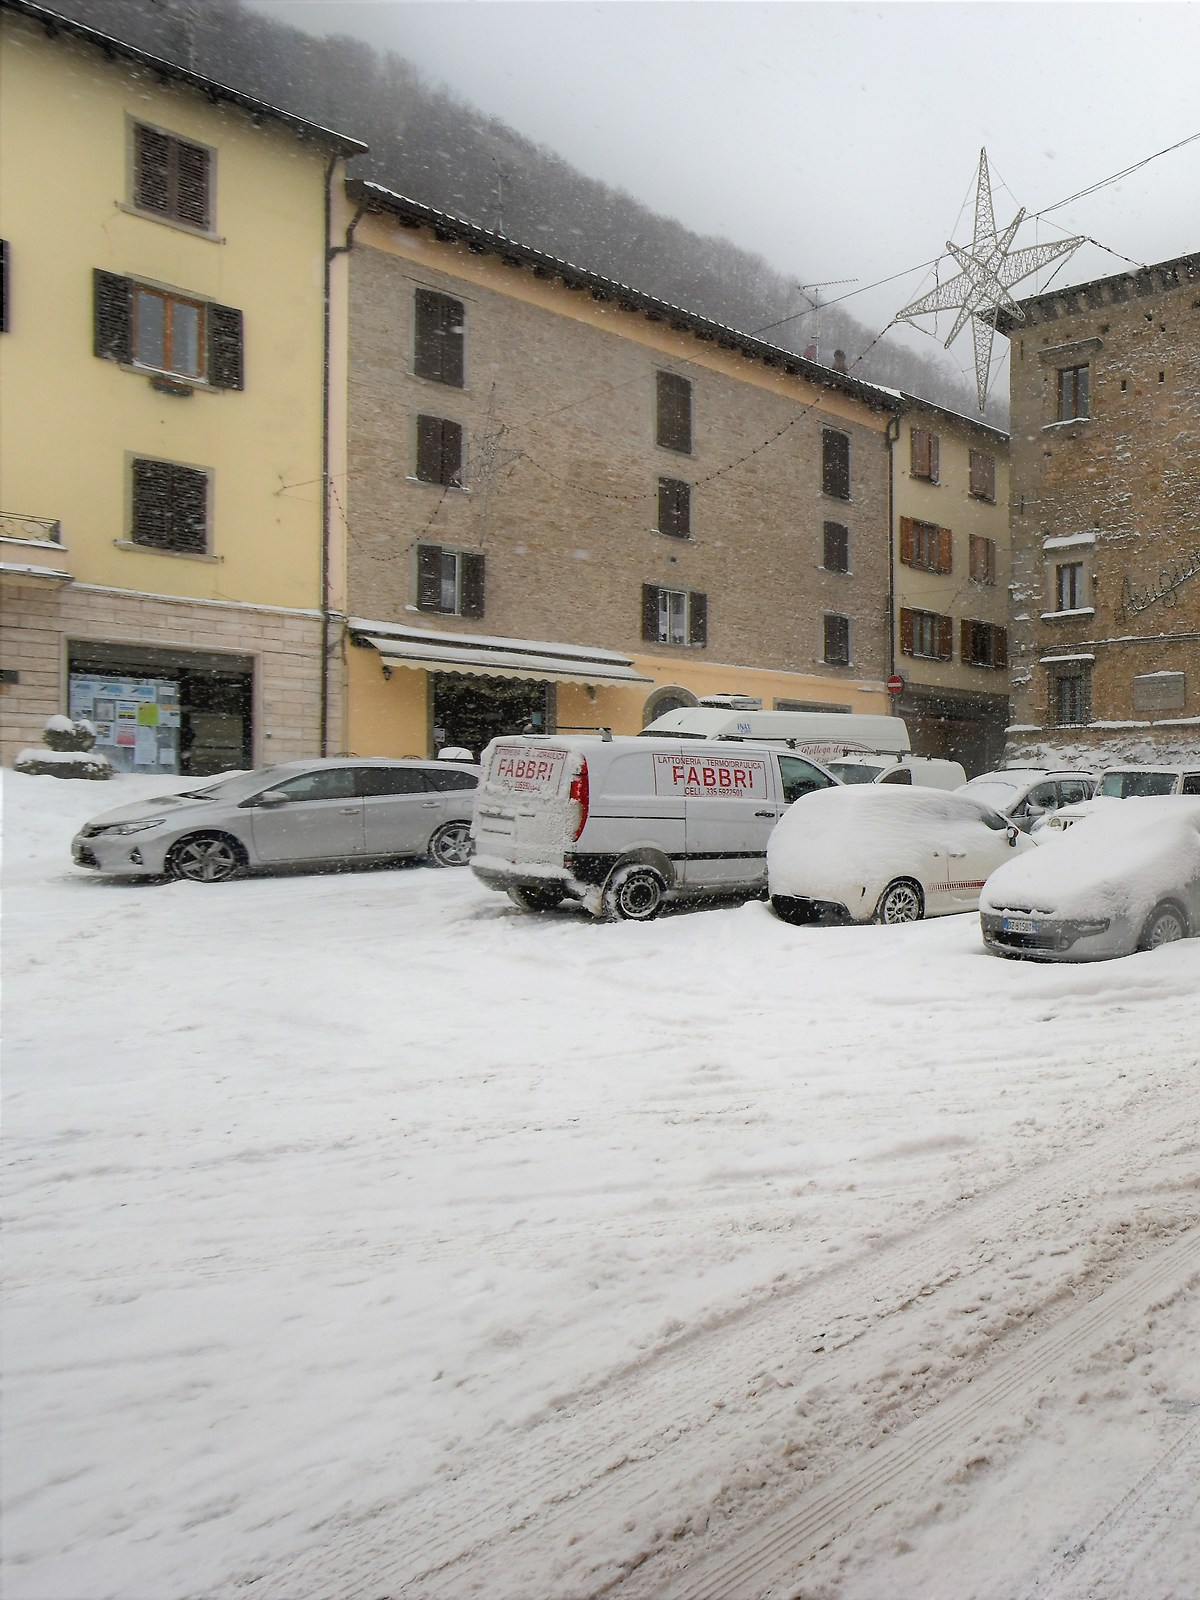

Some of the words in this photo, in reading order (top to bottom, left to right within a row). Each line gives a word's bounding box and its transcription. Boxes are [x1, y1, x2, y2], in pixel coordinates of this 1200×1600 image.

[497, 758, 554, 781] FABBRI
[657, 756, 702, 766] LATTONERIA
[672, 765, 753, 788] FABBRI
